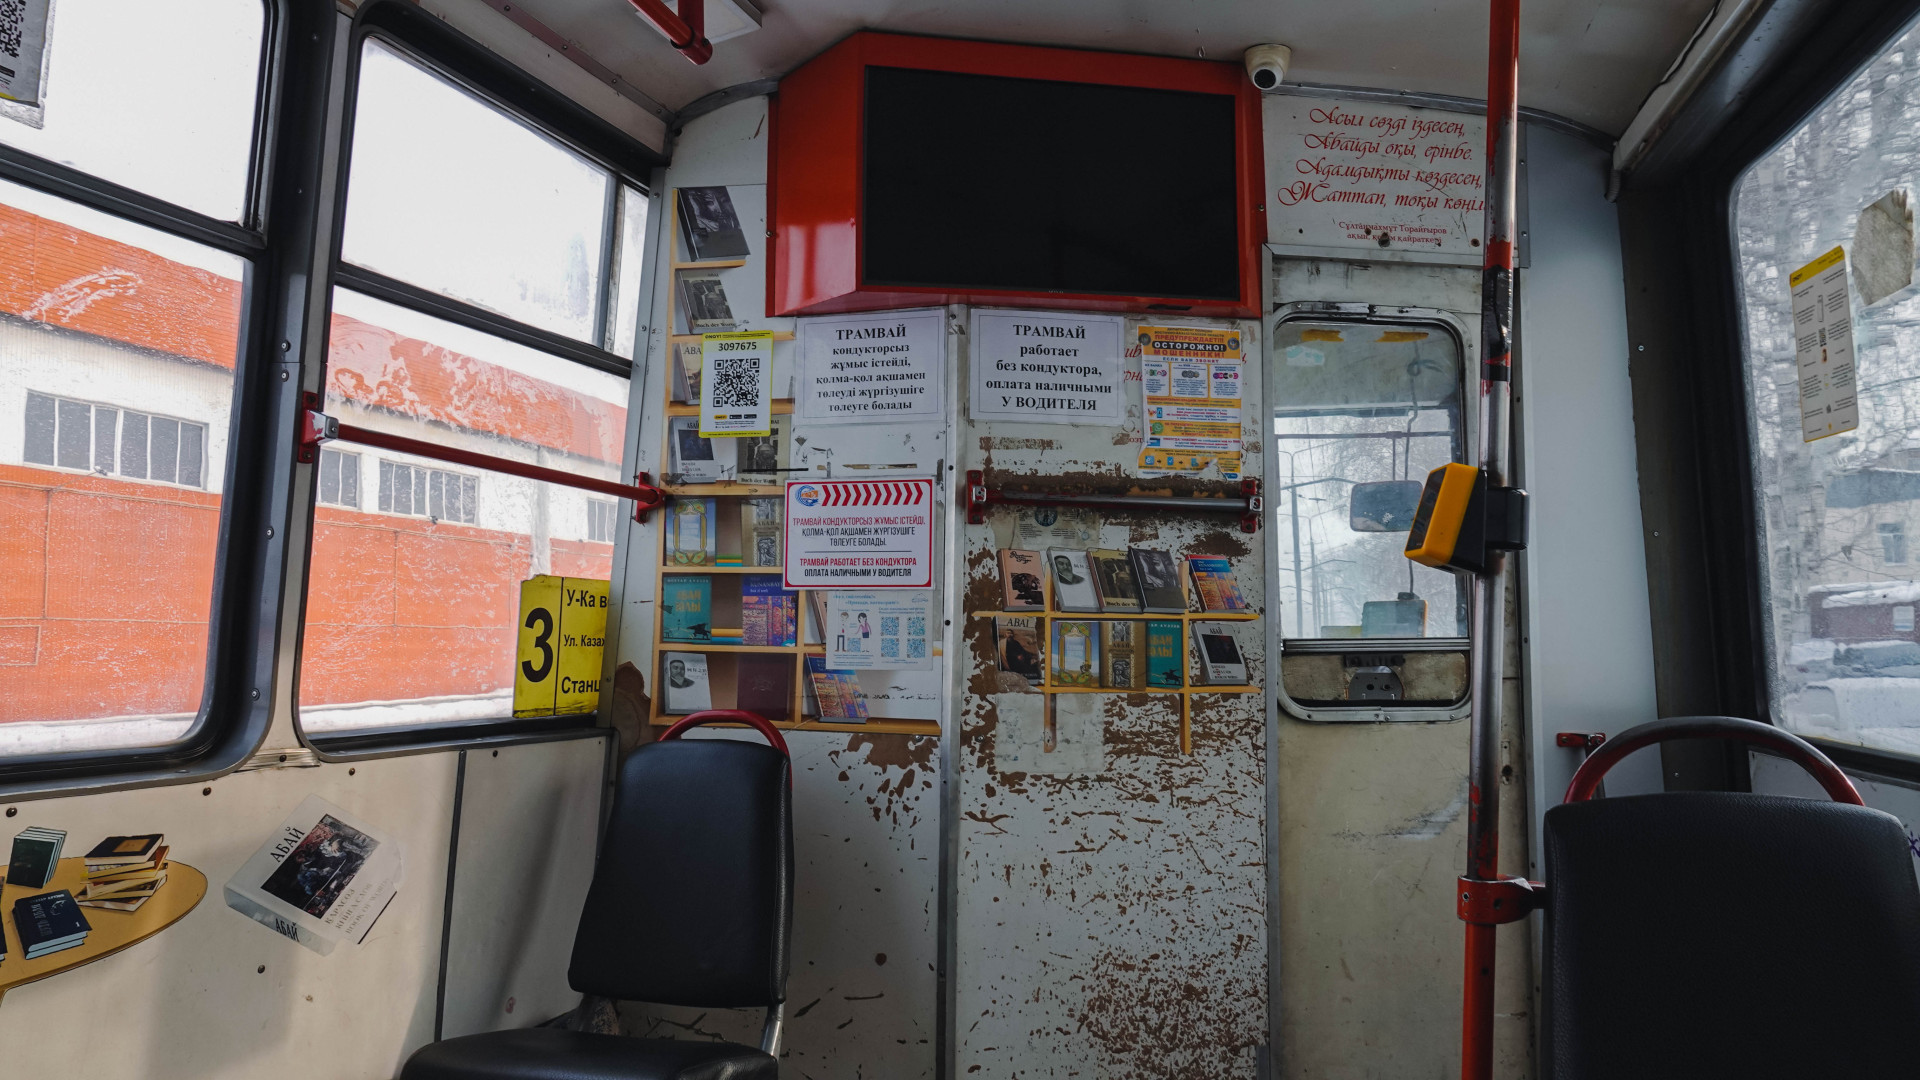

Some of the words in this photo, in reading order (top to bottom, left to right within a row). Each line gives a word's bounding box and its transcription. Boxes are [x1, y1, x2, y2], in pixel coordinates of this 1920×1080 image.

[1309, 107, 1364, 127] Асыл
[1369, 114, 1408, 137] сөзді
[1408, 116, 1465, 140] іздесең,
[1304, 132, 1380, 159] Абайды
[1385, 143, 1417, 159] оқы,
[1424, 141, 1473, 164] ерінбе.
[1296, 157, 1409, 184] Адамдықты
[1415, 170, 1483, 192] көздесең,
[1277, 180, 1387, 208] Жаттап,
[1394, 193, 1438, 211] тоқы
[1399, 223, 1447, 237] Торайғыров
[1346, 232, 1371, 242] ақын,
[836, 324, 906, 340] ТРАМВАЙ
[1013, 324, 1086, 339] ТРАМВАЙ
[718, 341, 757, 352] 3097675
[832, 344, 910, 356] кондукторсыз
[1020, 345, 1080, 357] работает
[1154, 342, 1224, 351] ОСТОРОЖНО!
[1153, 349, 1225, 358] МОШЕННИКИ!
[830, 360, 869, 371] жұмыс
[871, 357, 911, 368] істейді,
[996, 360, 1017, 371] без
[1020, 363, 1102, 377] кондуктора,
[816, 374, 873, 384] қолма-қол
[876, 372, 926, 382] ақшамен
[858, 385, 925, 398] жүргізушіге
[986, 380, 1031, 390] оплата
[1035, 382, 1112, 393] наличными
[871, 400, 912, 411] болады
[1001, 396, 1011, 407] У
[1016, 396, 1097, 411] ВОДИТЕЛЯ
[793, 516, 822, 526] ТРАМВАЙ
[822, 516, 872, 526] КОНДУКТОРСЫЗ
[873, 516, 899, 525] ЖҰМЫС
[802, 527, 840, 537] ҚОЛМА-ҚОЛ
[840, 527, 872, 536] АҚШАМЕН
[873, 526, 915, 536] ЖҮРГІЗУШІГЕ
[830, 538, 857, 547] ТӨЛЕУГЕ
[800, 557, 829, 566] ТРАМВАЙ
[830, 557, 861, 566] РАБОТАЕТ
[862, 557, 874, 566] БЕЗ
[875, 557, 917, 567] КОНДУКТОРА
[804, 568, 829, 577] ОПЛАТА
[830, 568, 872, 577] НАЛИЧНЫМИ
[872, 568, 877, 577] У
[878, 568, 912, 578] ВОДИТЕЛЯ
[566, 589, 595, 608] У-Ка
[600, 596, 608, 608] в
[1006, 616, 1030, 628] ABAI
[521, 607, 554, 683] 3
[563, 634, 578, 647] Ул.
[270, 826, 305, 863] АБАЙ
[275, 917, 300, 942] АБАЙ
